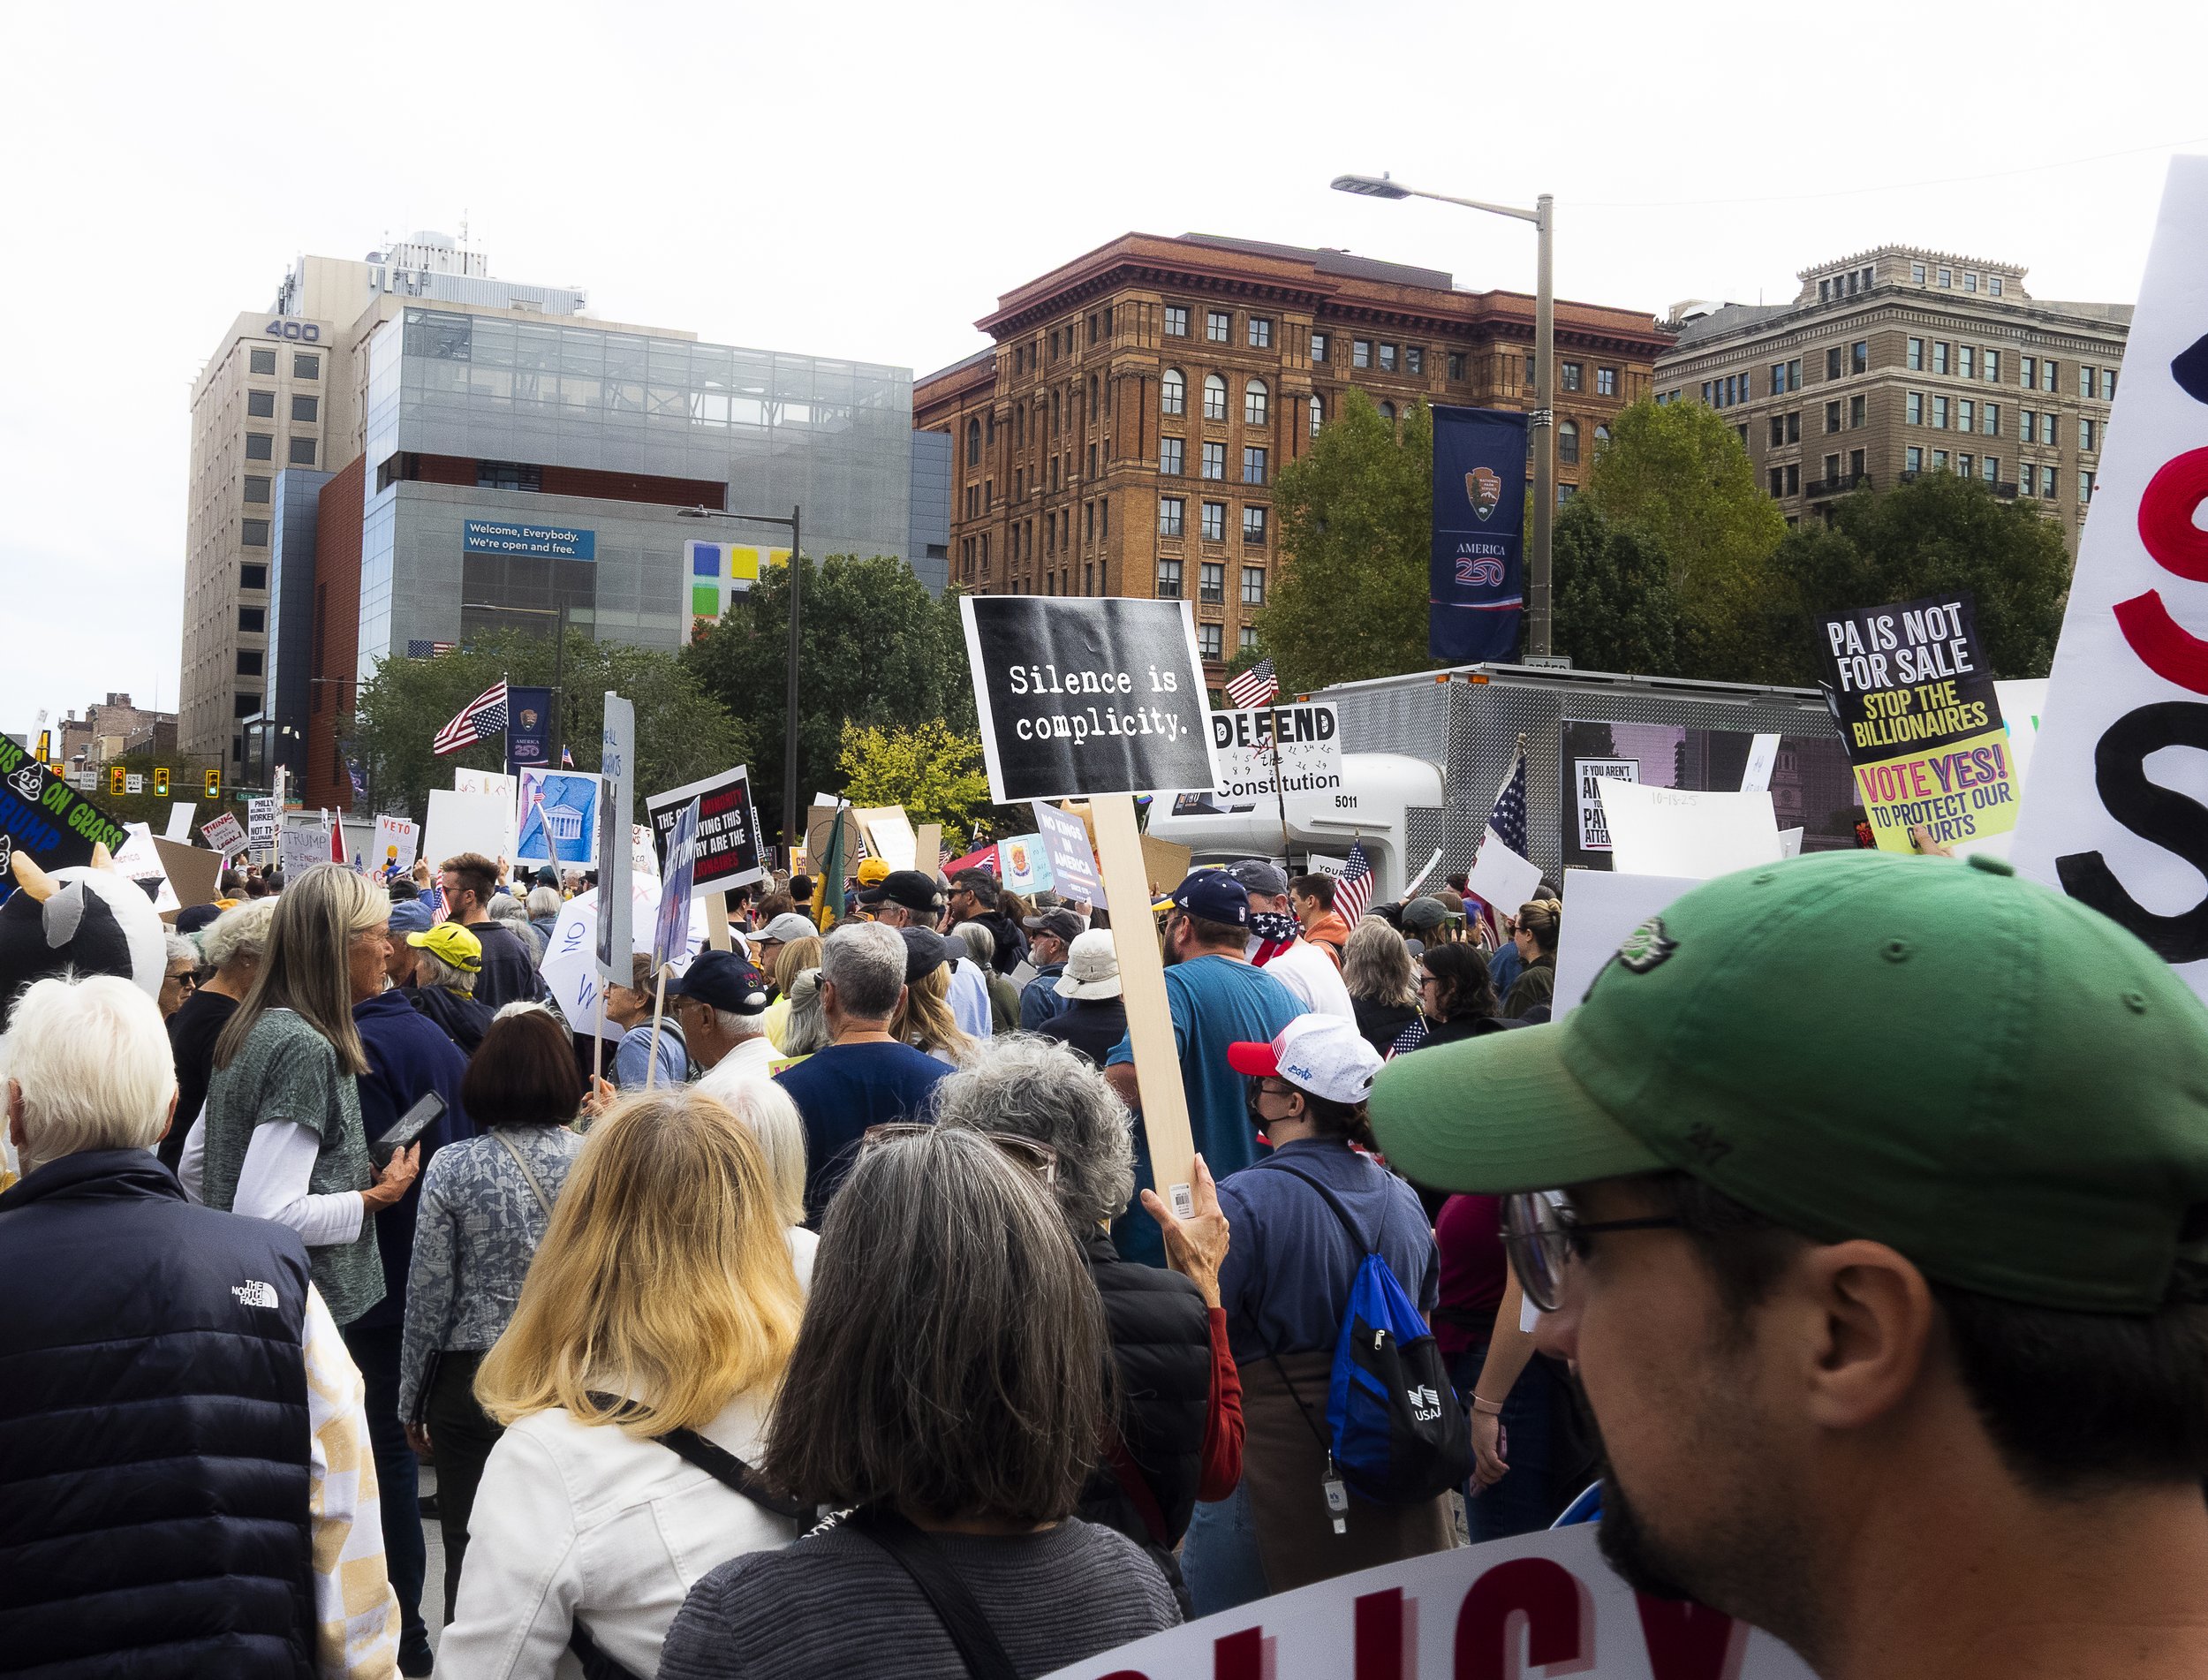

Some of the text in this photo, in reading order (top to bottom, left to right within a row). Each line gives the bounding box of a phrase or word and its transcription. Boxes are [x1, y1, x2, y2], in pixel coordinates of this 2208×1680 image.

[266, 320, 320, 341] 400
[469, 523, 579, 542] Welcome, Everybody.
[469, 537, 575, 555] We're open and free.
[1456, 543, 1505, 556] AMERICA
[1455, 557, 1505, 587] 250
[1826, 602, 1964, 657] PA IS NOT
[1836, 638, 1974, 692] FOR SALE
[1009, 664, 1178, 695] Silence is
[1863, 688, 1911, 720] STOP
[1915, 680, 1961, 712] THE
[1016, 707, 1188, 745] complicity.
[1212, 707, 1335, 749] DEFEND
[1851, 700, 1989, 748] BILLIONAIRES
[515, 745, 540, 757] 250
[1261, 753, 1284, 767] the
[1583, 765, 1630, 776] IF YOU AREN'T
[1859, 744, 2009, 804] VOTE YES!
[1217, 772, 1340, 798] Consttution
[657, 813, 675, 829] THE
[701, 788, 743, 816] MINORITY
[1335, 795, 1357, 808] 5011
[1652, 791, 1699, 806] 10-18-25
[1872, 781, 2014, 829] TO PROTECT OUR
[42, 782, 74, 815] ON
[68, 803, 123, 852] GRASS
[203, 812, 233, 834] THINK
[383, 818, 411, 835] VETO
[722, 810, 742, 829] THIS
[1041, 814, 1084, 842] NO KINGS
[1585, 829, 1613, 844] ATTEN
[1907, 814, 1977, 849] CURTS
[283, 831, 327, 848] TRUMP
[709, 839, 729, 854] ARE
[727, 829, 746, 848] THE
[1061, 837, 1073, 854] IN
[285, 851, 299, 861] The
[300, 853, 323, 863] ENEMY
[1054, 851, 1093, 876] AMERICA
[231, 1285, 262, 1299] NORTH
[245, 1279, 264, 1290] THE
[239, 1296, 263, 1306] FACE
